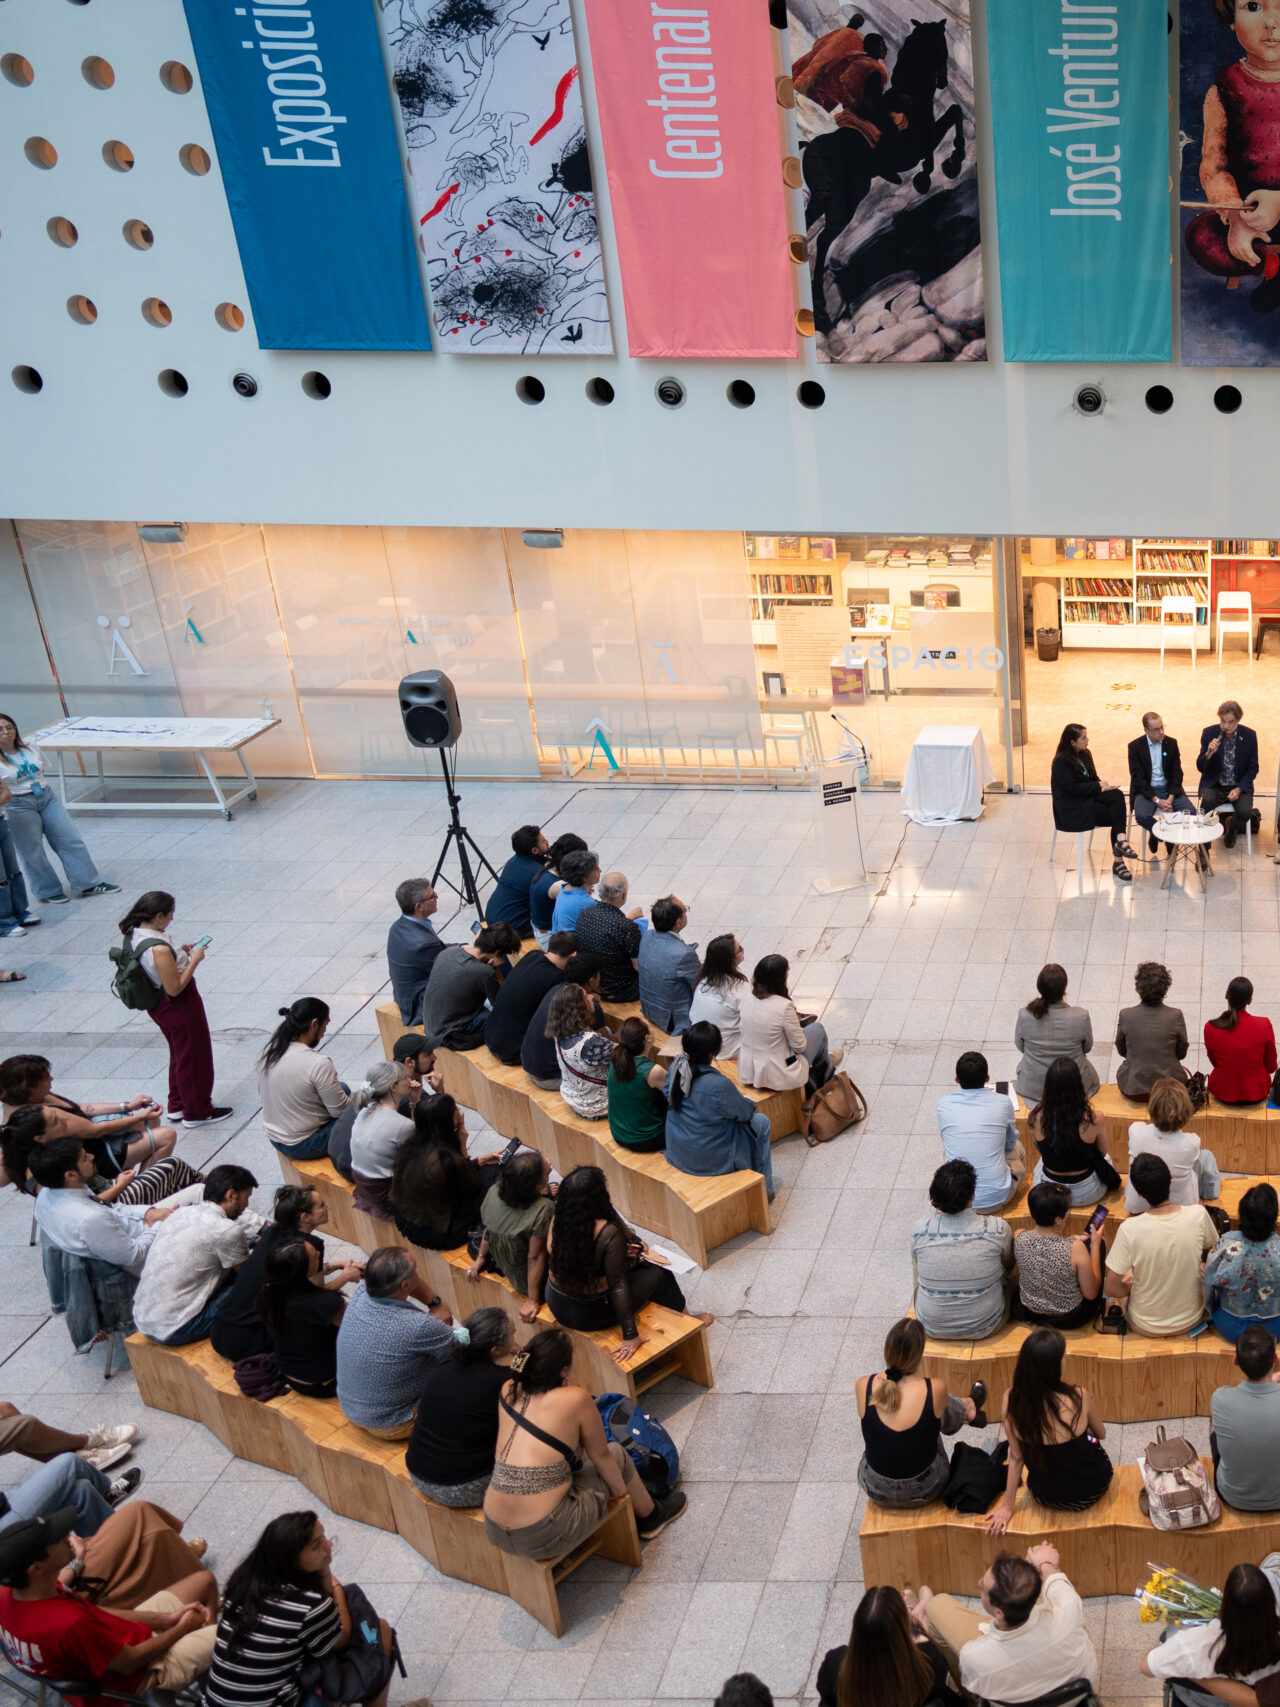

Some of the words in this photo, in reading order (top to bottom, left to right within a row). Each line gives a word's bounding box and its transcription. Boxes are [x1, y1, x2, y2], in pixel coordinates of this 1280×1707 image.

[235, 0, 347, 167] Exposici
[1049, 144, 1122, 221] José
[844, 645, 1005, 671] ESPACIO
